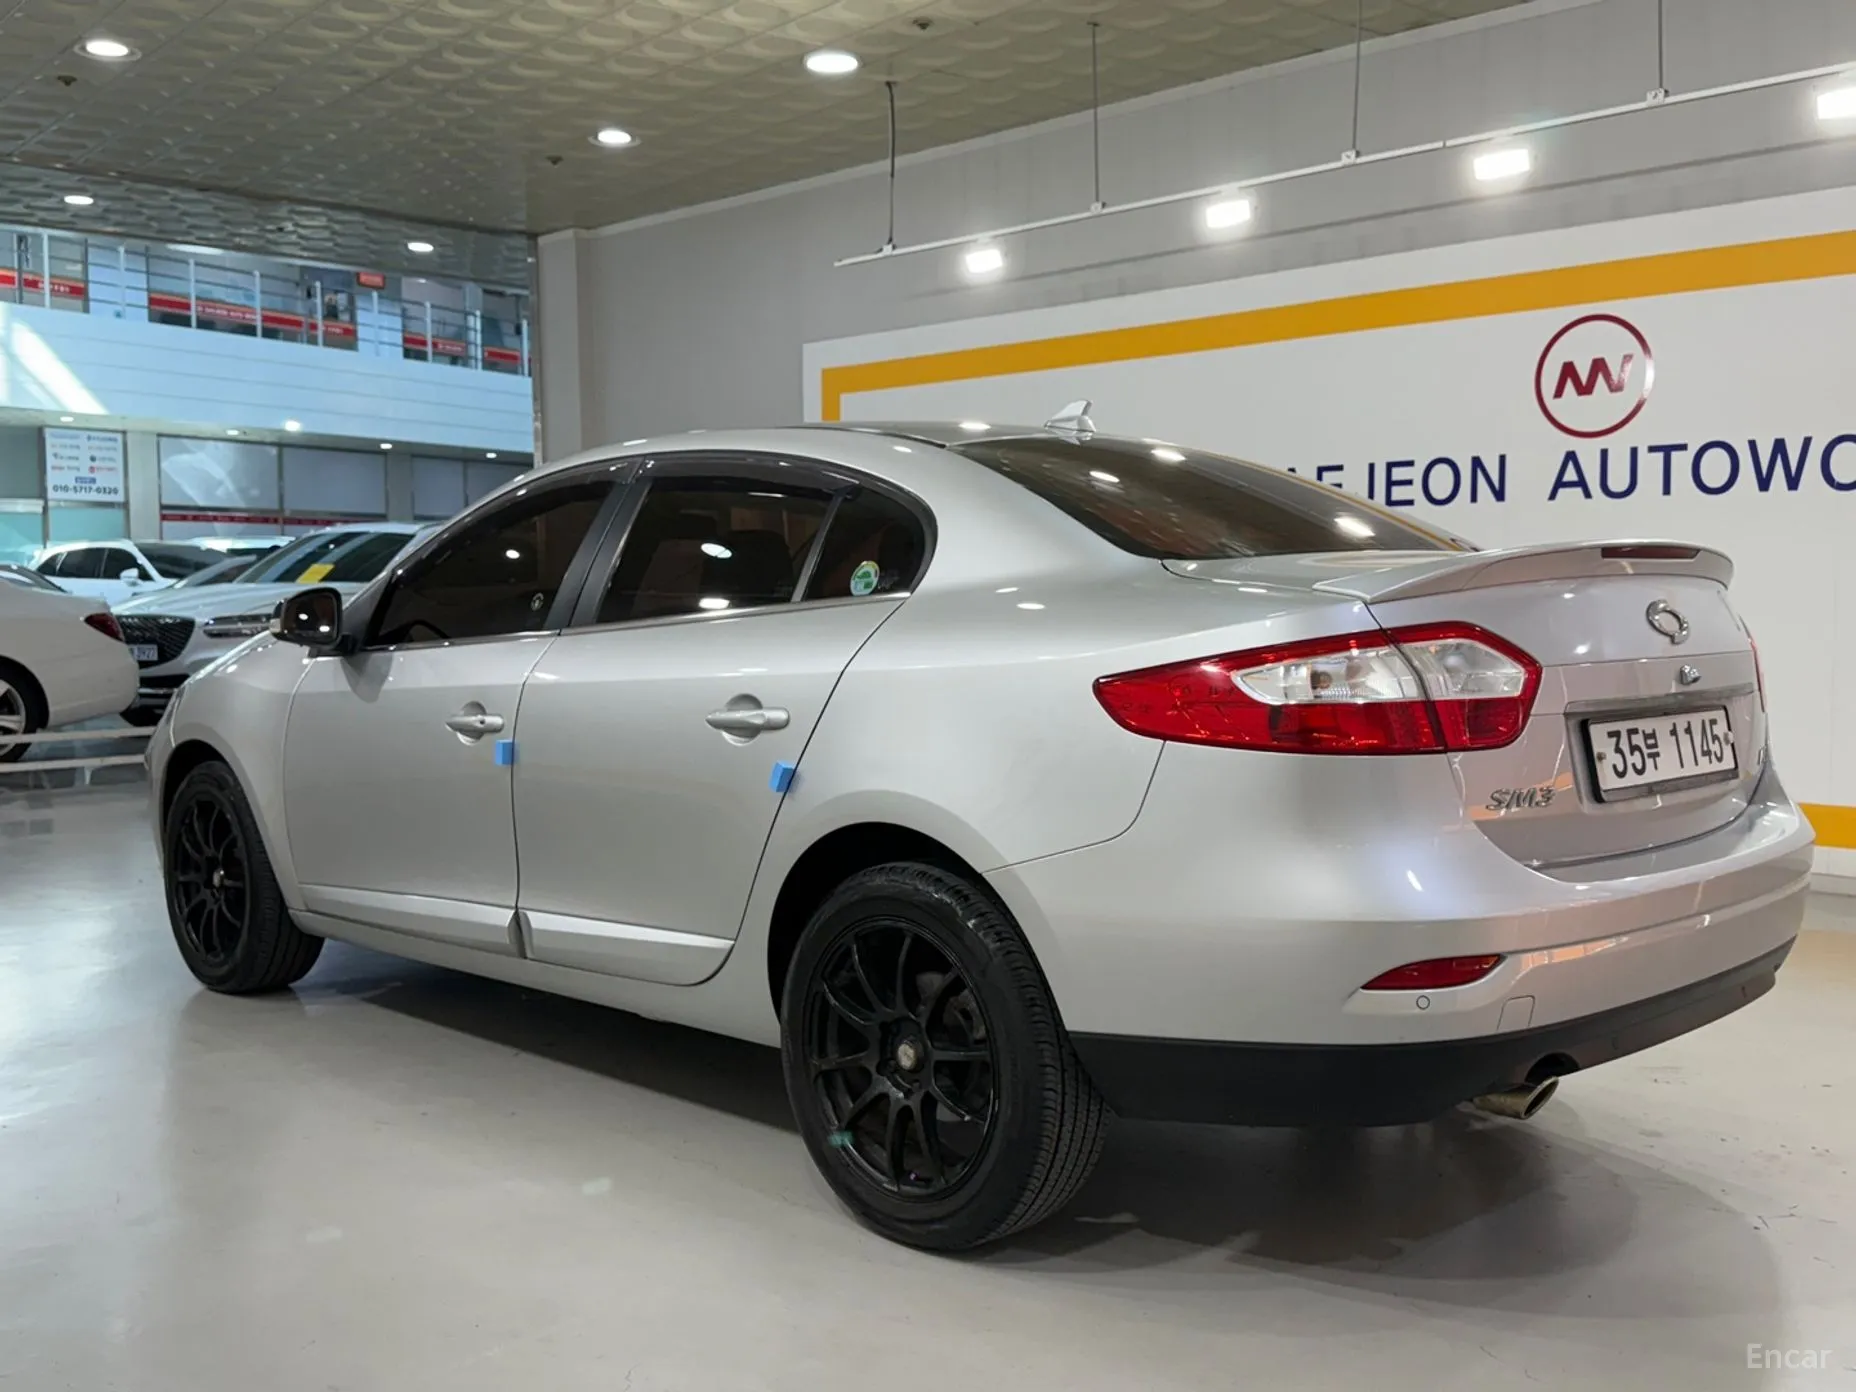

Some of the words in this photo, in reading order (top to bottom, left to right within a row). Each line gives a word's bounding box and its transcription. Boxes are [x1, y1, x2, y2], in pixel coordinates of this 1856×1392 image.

[1607, 726, 1661, 779] 35부
[1669, 718, 1724, 769] 1145
[1485, 787, 1556, 811] SM3
